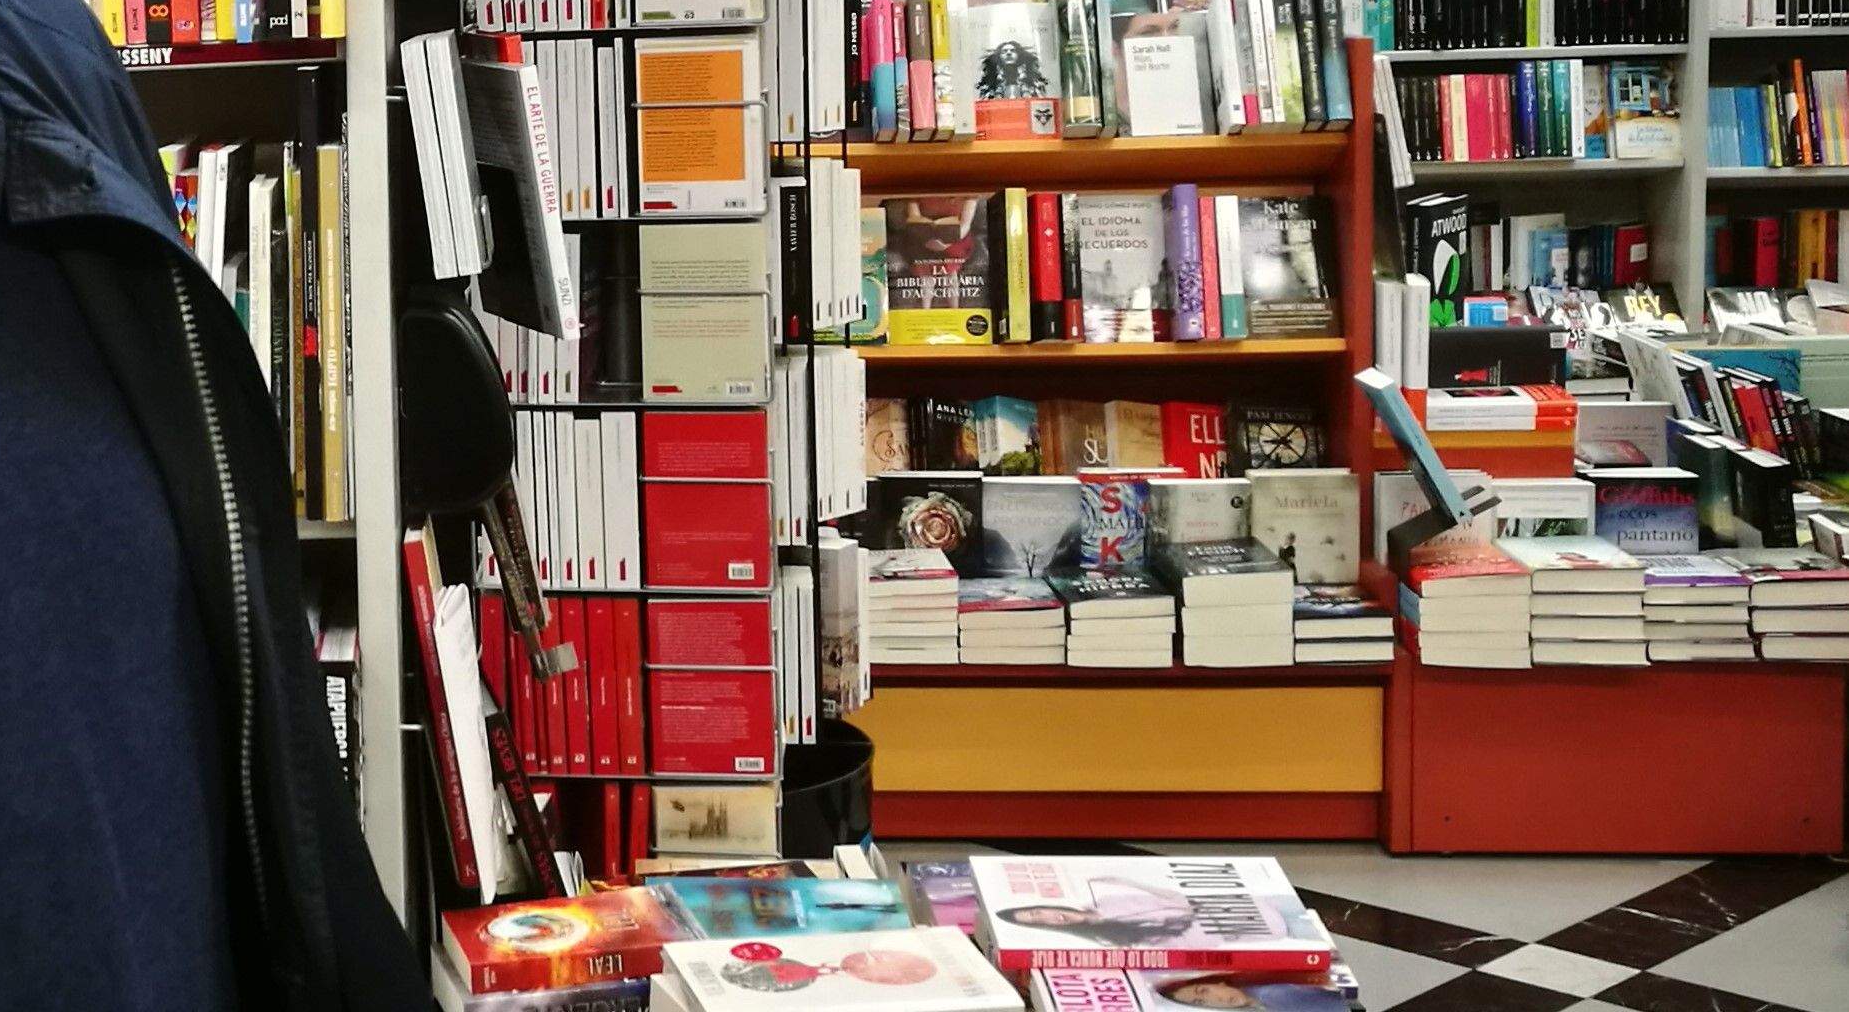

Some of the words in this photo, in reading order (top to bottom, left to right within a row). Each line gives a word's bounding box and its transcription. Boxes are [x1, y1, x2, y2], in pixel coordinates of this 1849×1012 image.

[118, 47, 173, 66] SSENY
[526, 85, 538, 100] EL
[528, 102, 544, 131] ARTE
[534, 134, 546, 149] DE
[538, 151, 550, 166] LA
[541, 169, 557, 214] GUERRA
[1263, 200, 1300, 215] Kate
[1097, 216, 1143, 227] IDIOMA
[1430, 213, 1469, 239] ATWOOD
[932, 265, 949, 275] LA
[1617, 528, 1695, 547] pantano
[1128, 950, 1141, 968] LO
[1143, 950, 1169, 968] TODO
